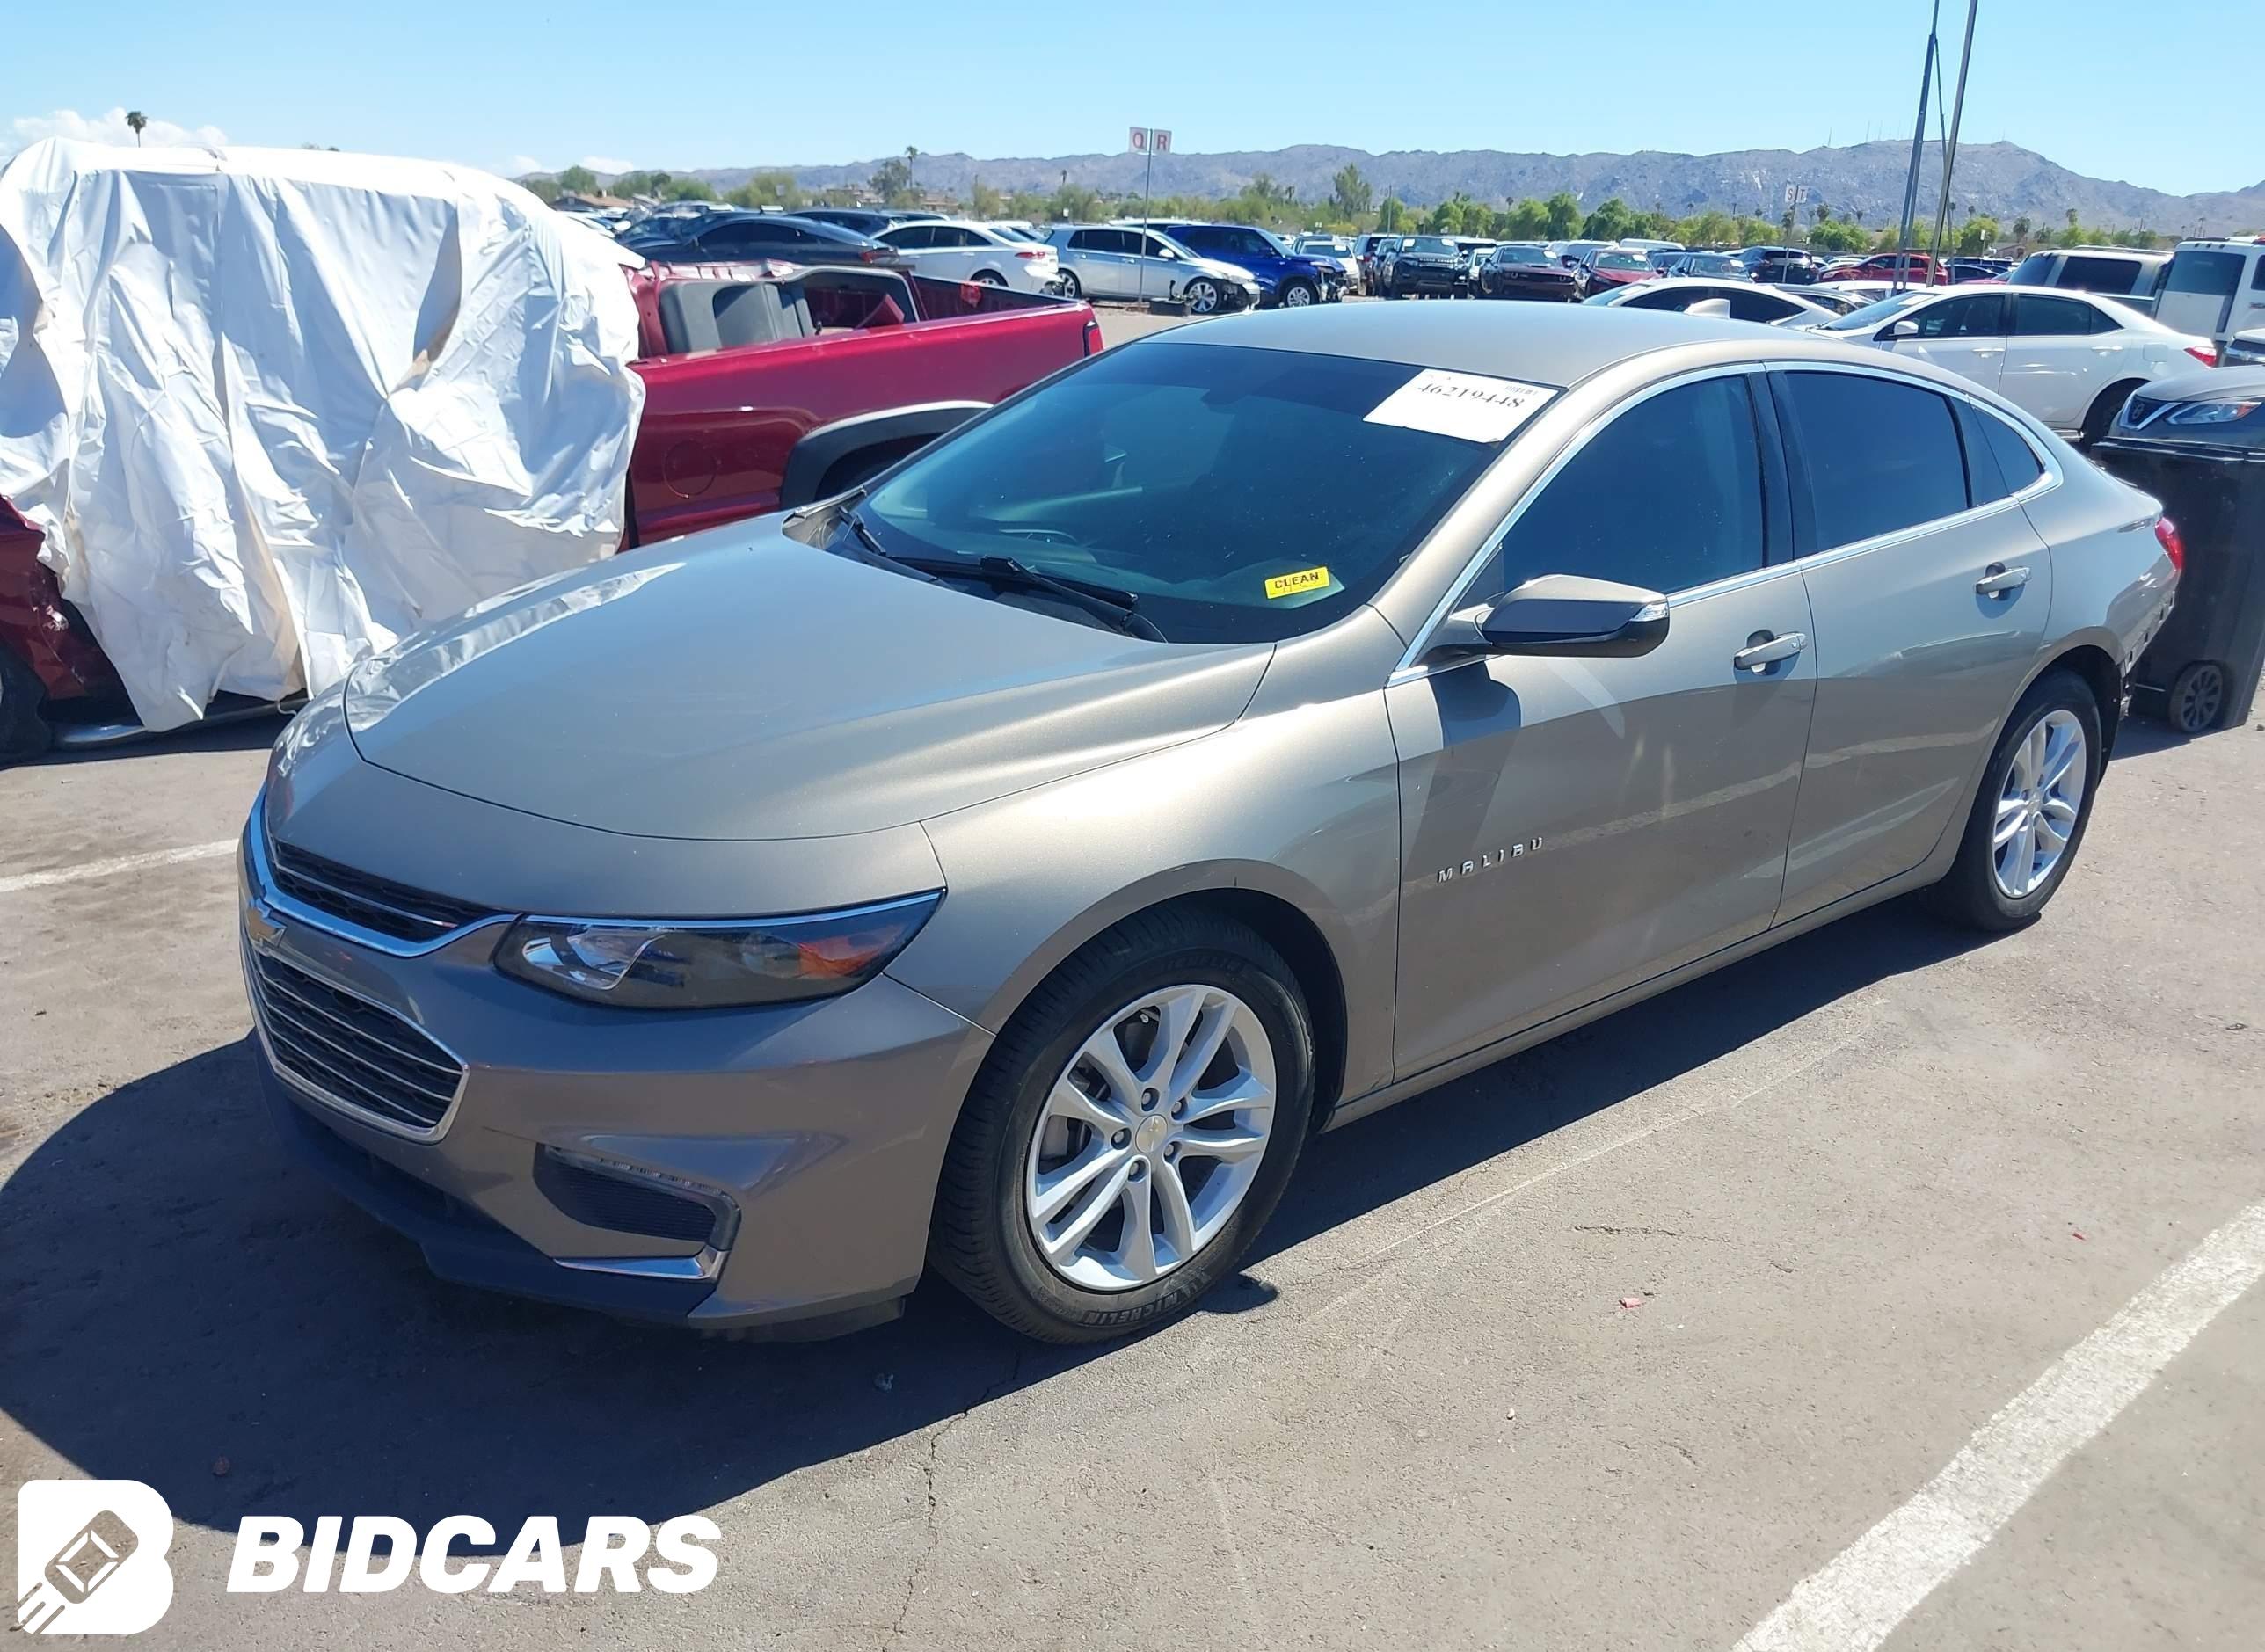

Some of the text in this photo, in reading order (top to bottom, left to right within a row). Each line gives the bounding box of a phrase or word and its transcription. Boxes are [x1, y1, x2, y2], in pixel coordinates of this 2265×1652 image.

[1157, 134, 1167, 150] R
[1787, 188, 1794, 200] S
[1417, 382, 1525, 408] 46219448
[1274, 571, 1319, 589] CLEAN
[1437, 836, 1543, 883] MALIBU
[1084, 1293, 1178, 1324] MICHELIN
